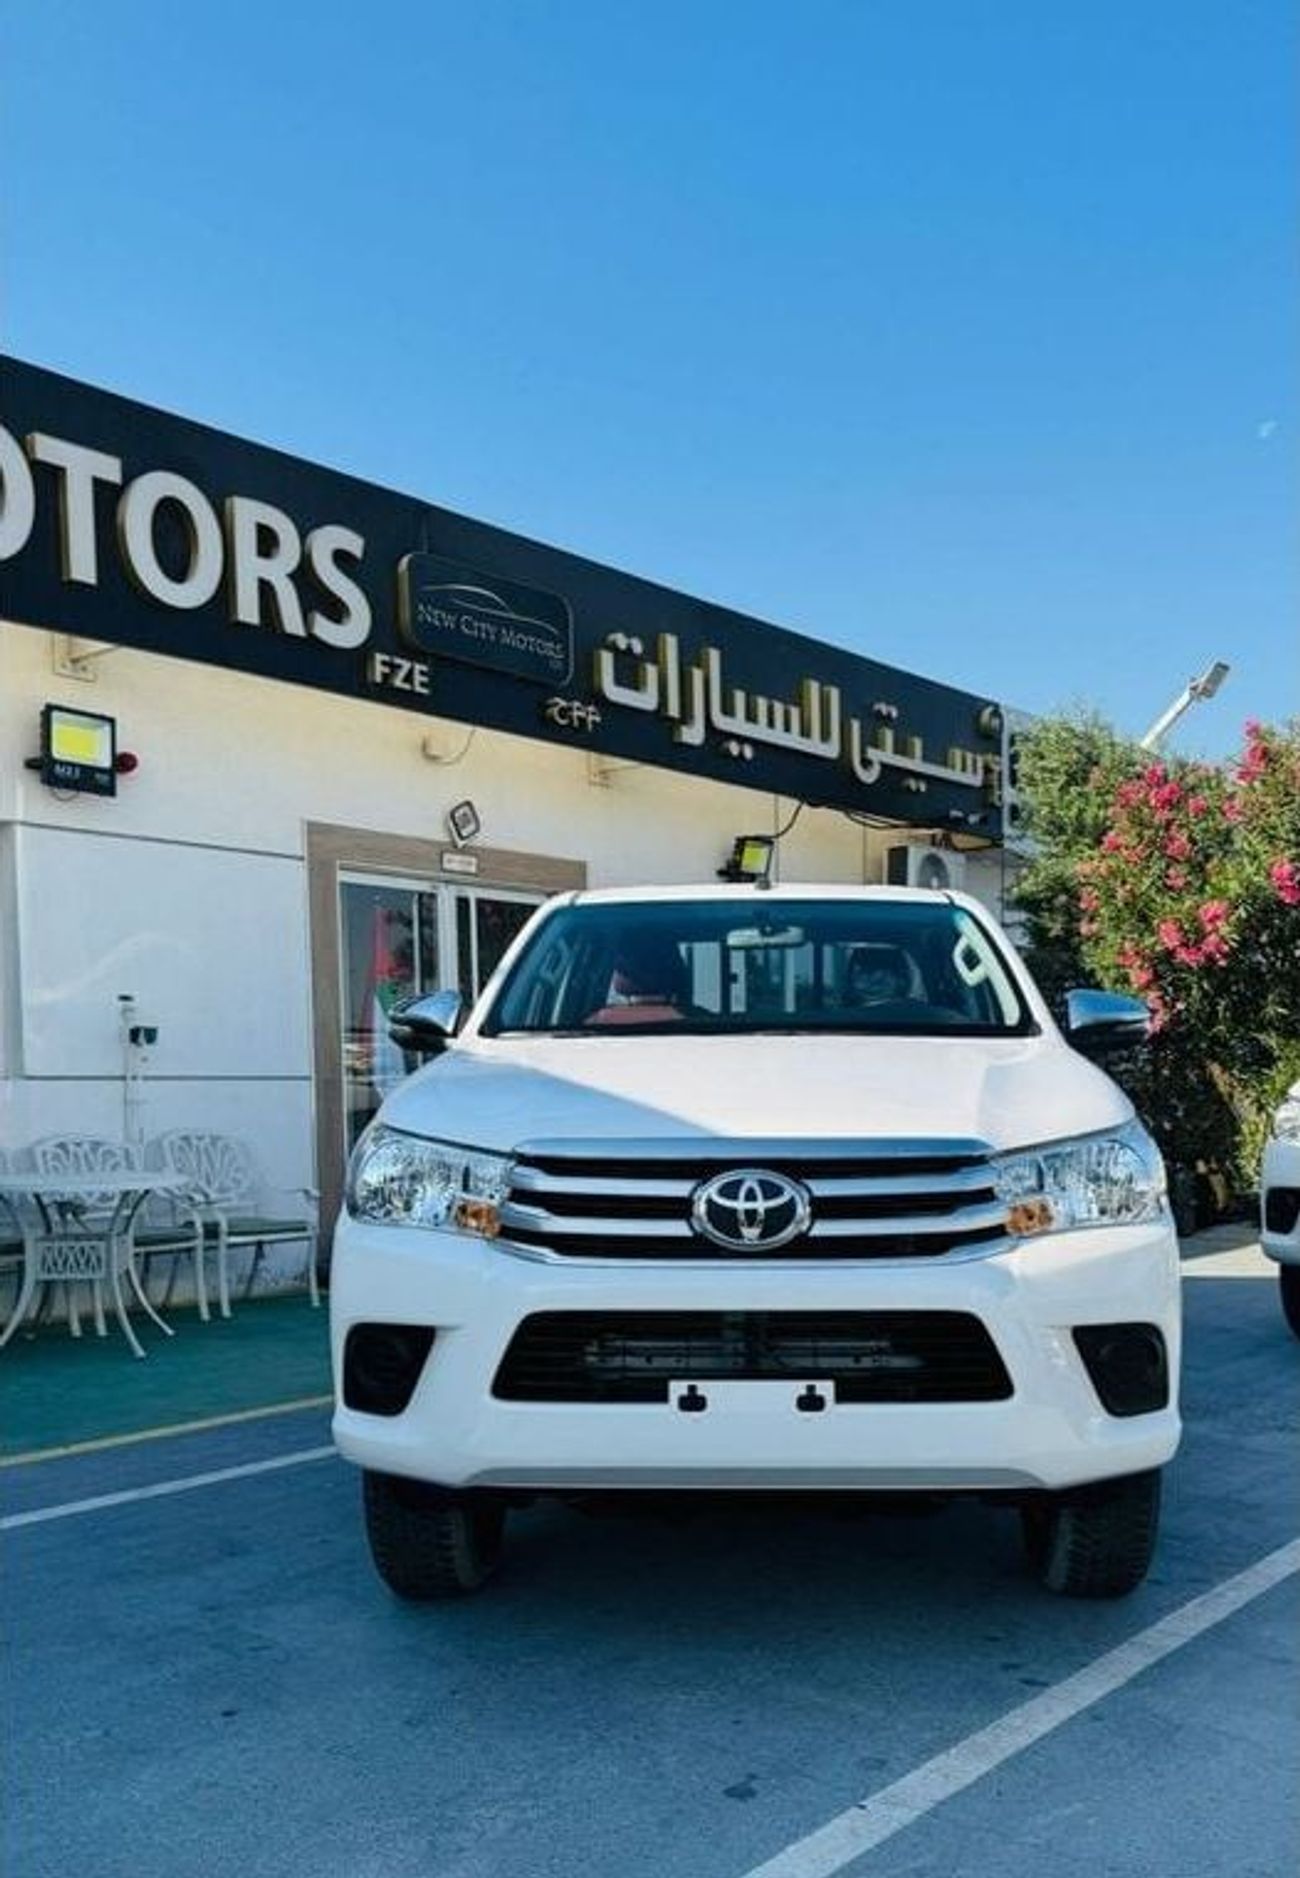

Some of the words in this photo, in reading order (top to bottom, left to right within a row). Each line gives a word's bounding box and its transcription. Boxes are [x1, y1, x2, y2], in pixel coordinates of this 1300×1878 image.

[459, 614, 497, 642] CITY
[500, 625, 566, 660] MOTORS
[371, 652, 431, 695] FZE
[596, 632, 841, 760] للسيارات
